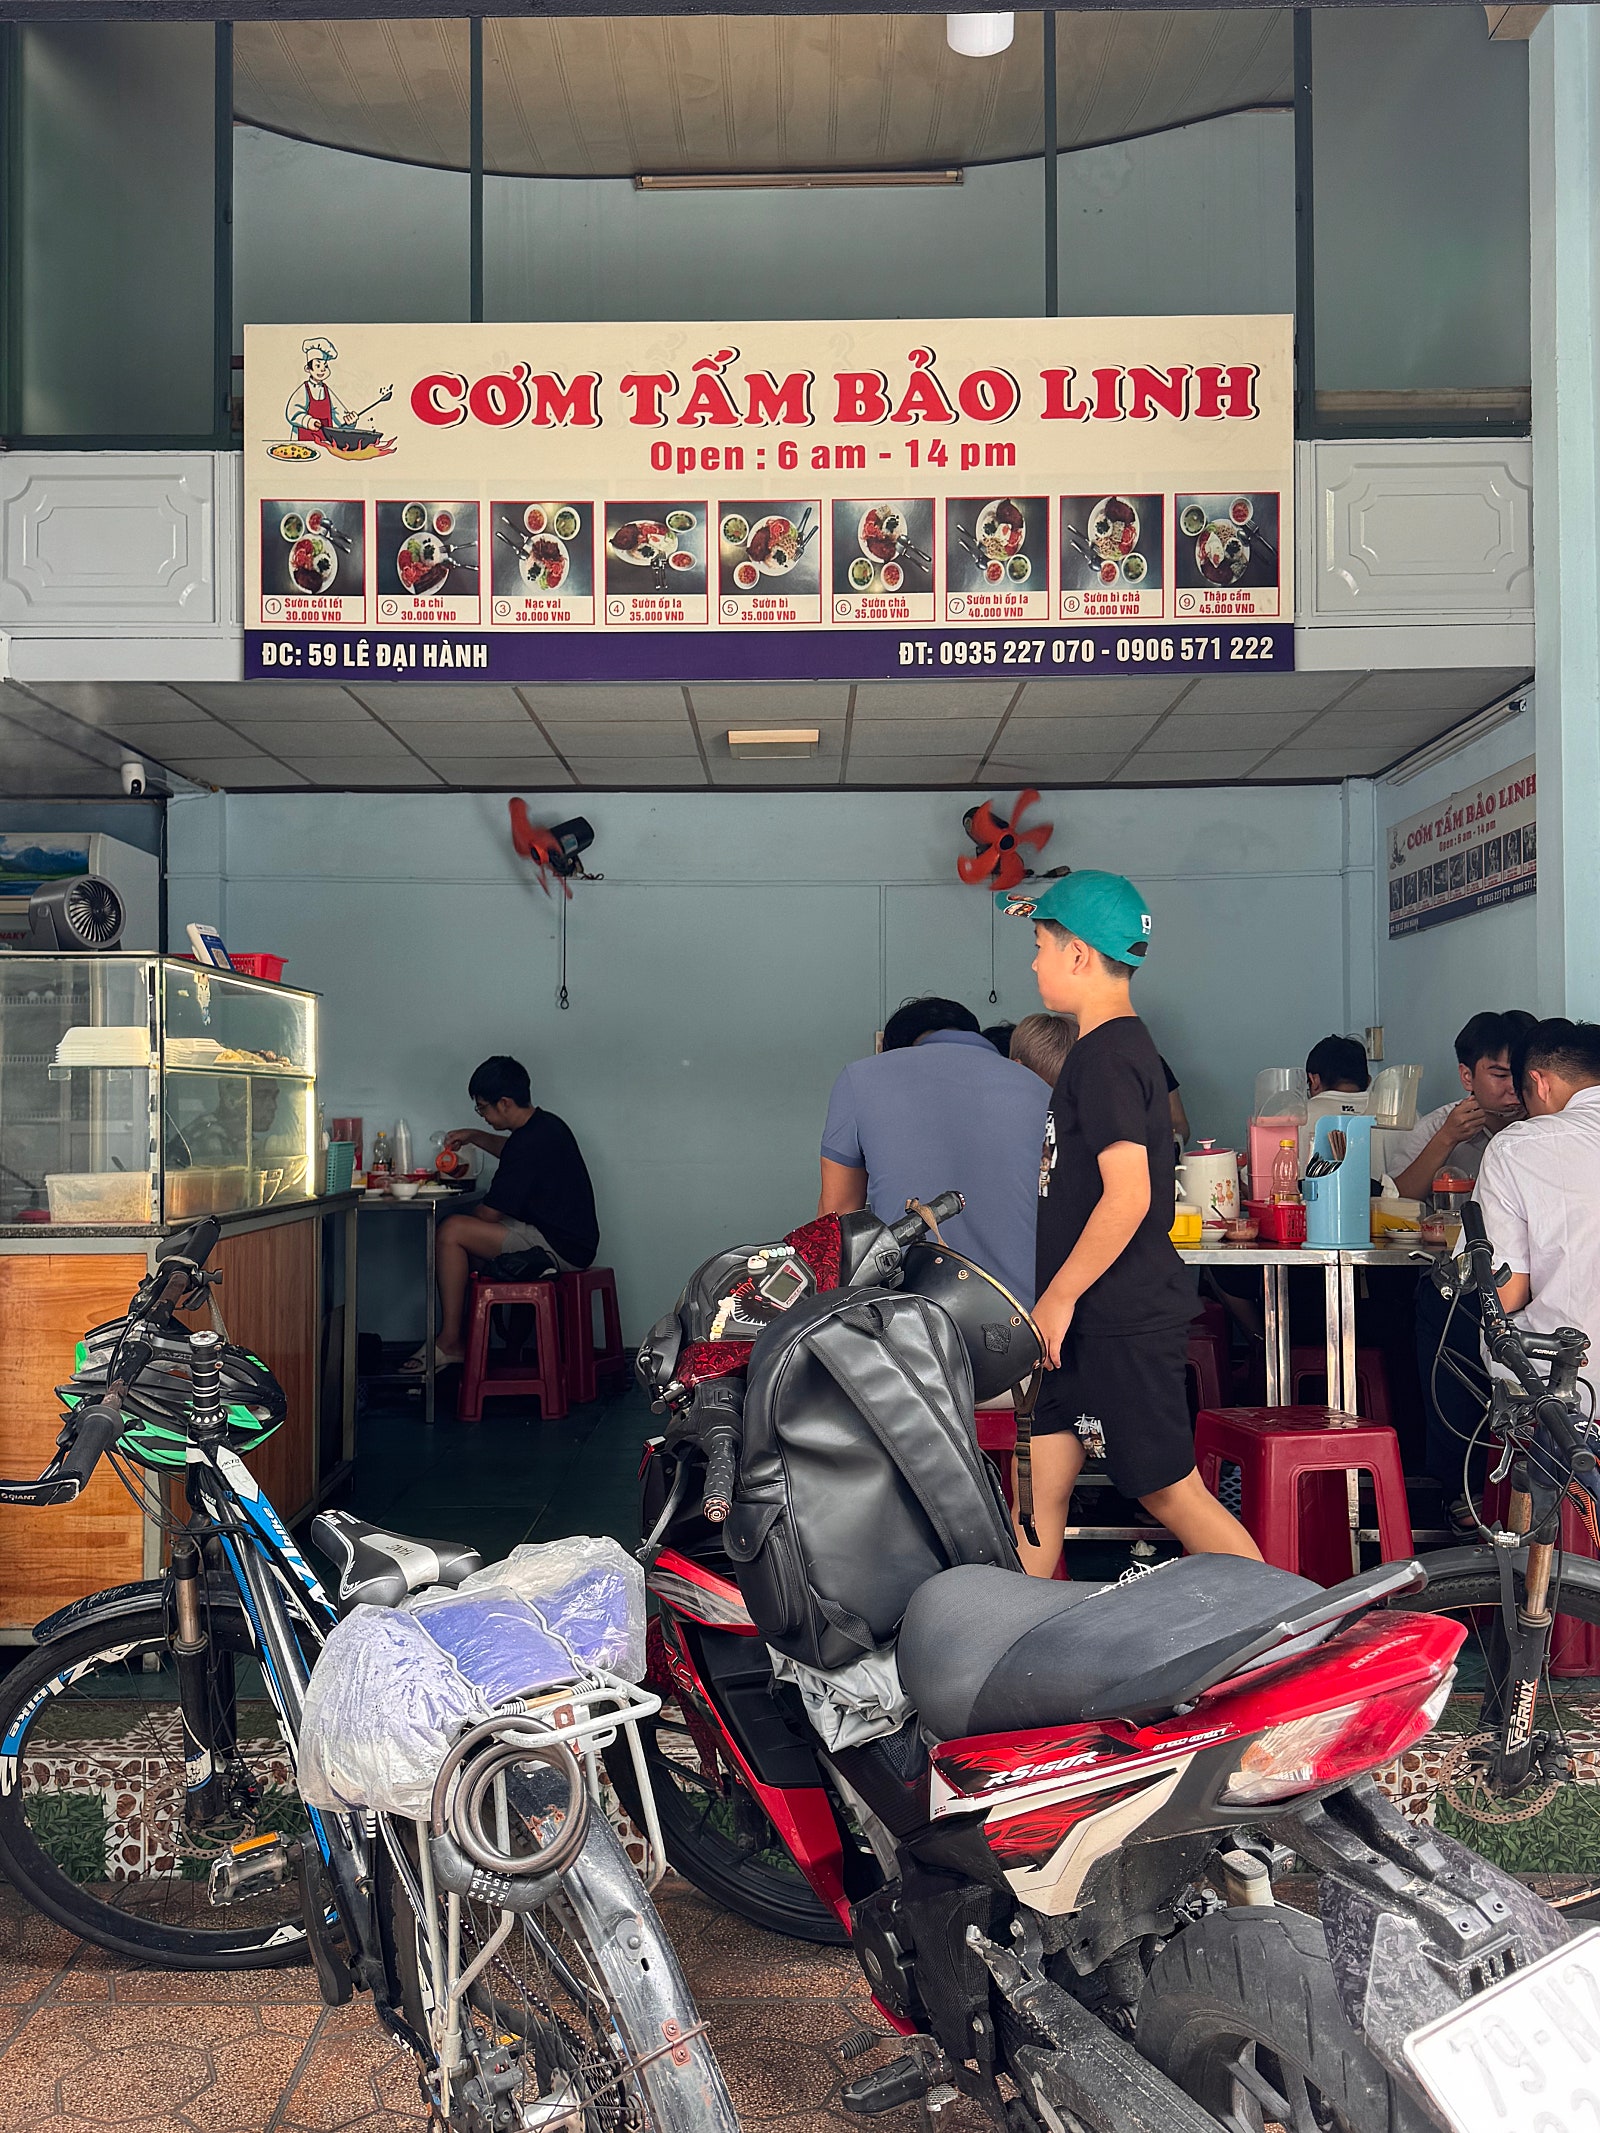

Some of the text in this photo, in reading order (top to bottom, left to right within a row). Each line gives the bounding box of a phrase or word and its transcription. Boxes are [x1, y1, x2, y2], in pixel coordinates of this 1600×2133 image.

[410, 345, 1262, 429] CƠM TẤM BẢO LINH
[650, 440, 745, 474] Open
[777, 440, 799, 470] 6
[811, 442, 867, 469] am
[905, 438, 949, 468] 14
[960, 441, 1018, 471] pm
[413, 598, 426, 608] Ba
[546, 599, 561, 609] vai
[672, 599, 682, 608] la
[1019, 594, 1029, 604] la
[854, 608, 910, 619] 35.000 VND
[968, 607, 1024, 618] 40.000 VND
[1084, 604, 1140, 615] 40.000 VND
[1200, 604, 1255, 614] 45.000 VND
[286, 611, 342, 622] 30.000 VND
[401, 611, 456, 621] 30.000 VND
[515, 611, 570, 622] 30.000 VND
[630, 611, 684, 622] 35.000 VND
[741, 610, 796, 621] 35.000 VND
[261, 639, 488, 672] ĐC: 59 LÊ ĐẠI HÀNH
[898, 641, 933, 665] ĐT:
[940, 641, 997, 664] 0935
[1003, 640, 1046, 664] 227
[1052, 639, 1095, 663] 070
[1116, 638, 1174, 662] 0906
[1181, 637, 1221, 660] 571
[1230, 636, 1274, 659] 222
[1513, 1679, 1536, 1741] FORNIX
[984, 1750, 1099, 1789] RS150R
